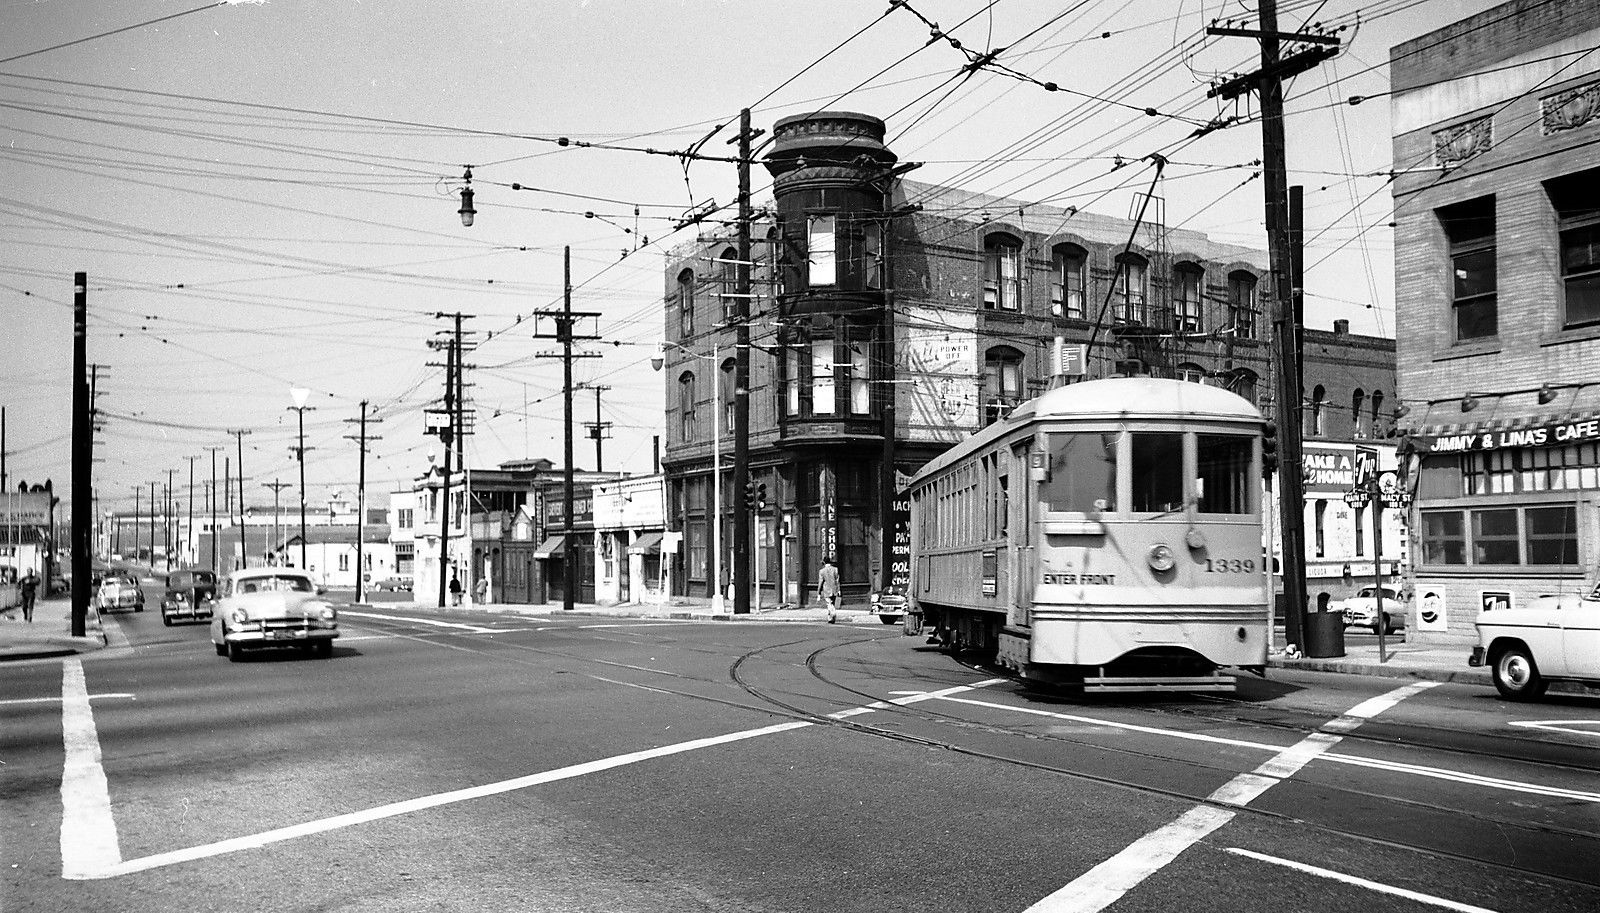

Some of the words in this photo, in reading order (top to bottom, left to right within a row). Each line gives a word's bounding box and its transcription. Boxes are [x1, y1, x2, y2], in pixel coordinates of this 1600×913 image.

[1430, 435, 1477, 452] JIMMY
[1481, 434, 1494, 449] &
[1500, 428, 1548, 447] LINA'S
[1555, 420, 1599, 441] CAFE
[1340, 455, 1352, 470] A
[1316, 469, 1354, 485] HOME
[1345, 493, 1360, 502] MAIN
[1381, 493, 1400, 502] MACY
[828, 527, 836, 559] SHOP
[1204, 558, 1255, 574] 1339
[1044, 573, 1077, 585] ENTER
[1080, 573, 1116, 585] FRONT
